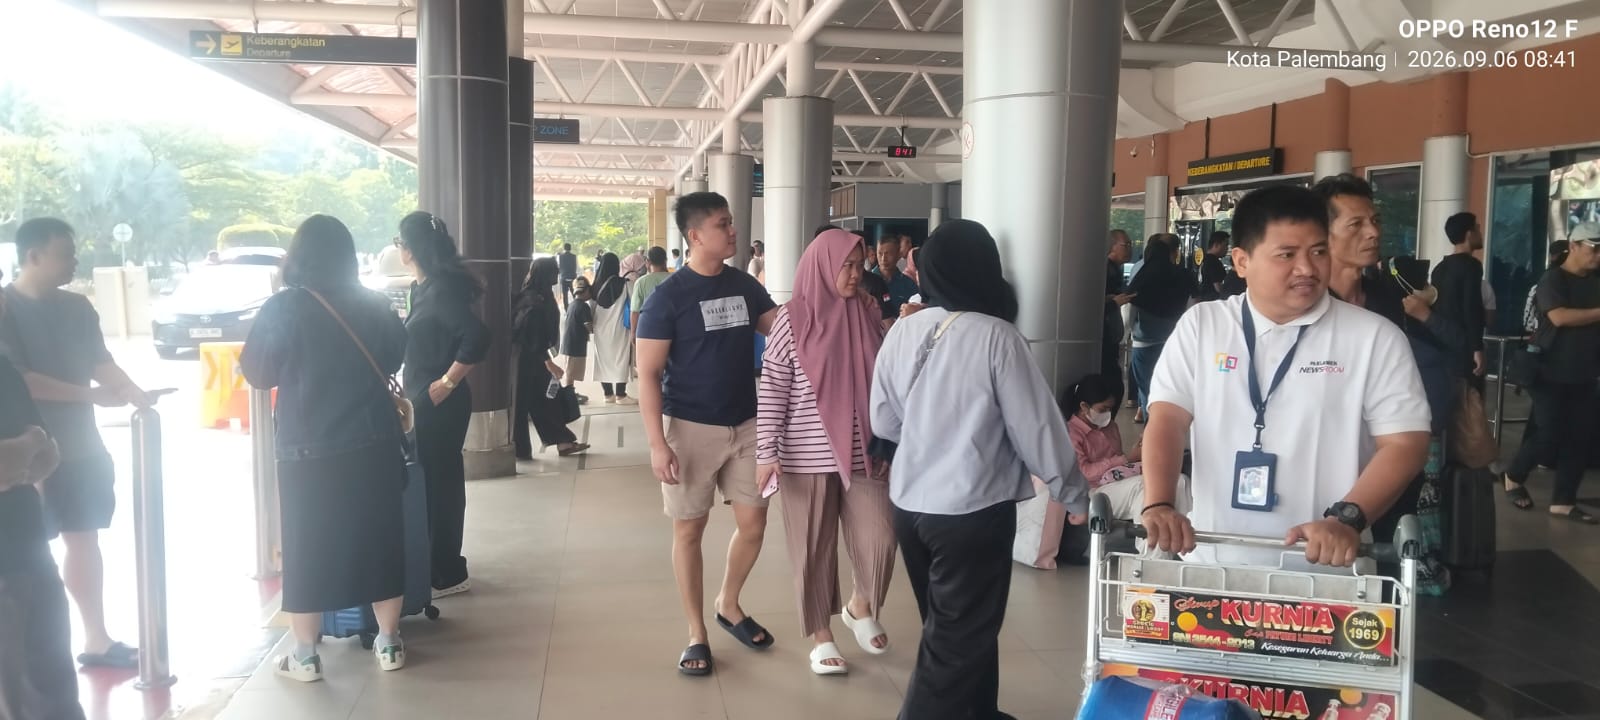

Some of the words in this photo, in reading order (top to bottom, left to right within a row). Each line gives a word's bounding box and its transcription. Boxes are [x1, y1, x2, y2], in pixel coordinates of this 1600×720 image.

[246, 35, 325, 48] Keberangkatan
[246, 48, 291, 58] Departure
[539, 125, 569, 135] ZONE
[1188, 161, 1233, 177] KEBERANGKATAN
[1236, 156, 1271, 170] DEPARTURE
[1299, 366, 1345, 374] NEWSROOM
[1220, 598, 1335, 634] KURNIA
[1352, 617, 1378, 628] Sejak
[1349, 627, 1380, 641] 1969
[1260, 642, 1310, 656] Kesegaran
[1310, 646, 1353, 659] Keluarga
